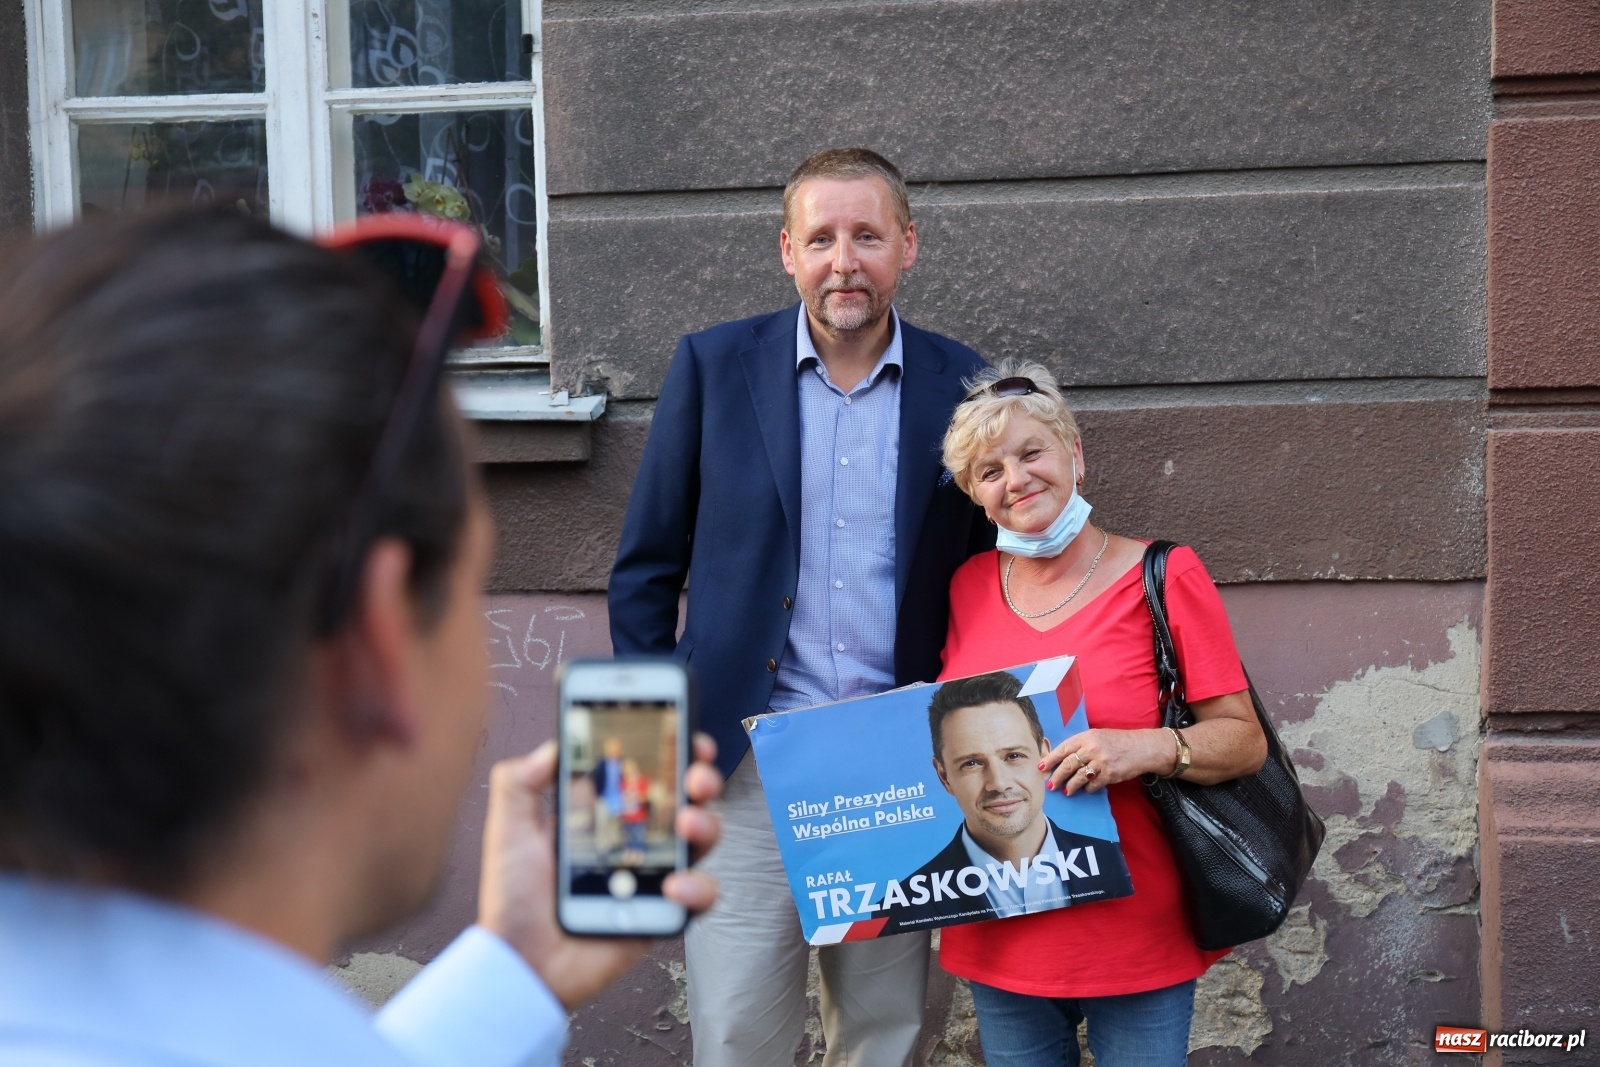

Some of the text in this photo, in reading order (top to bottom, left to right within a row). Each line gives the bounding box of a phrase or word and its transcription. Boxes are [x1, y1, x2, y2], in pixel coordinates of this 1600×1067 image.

[787, 782, 925, 817] Silny Prezydent
[792, 803, 934, 839] Wspólna Polska
[806, 870, 853, 888] RAFAŁ
[808, 845, 1100, 919] TRZASKOWSKI
